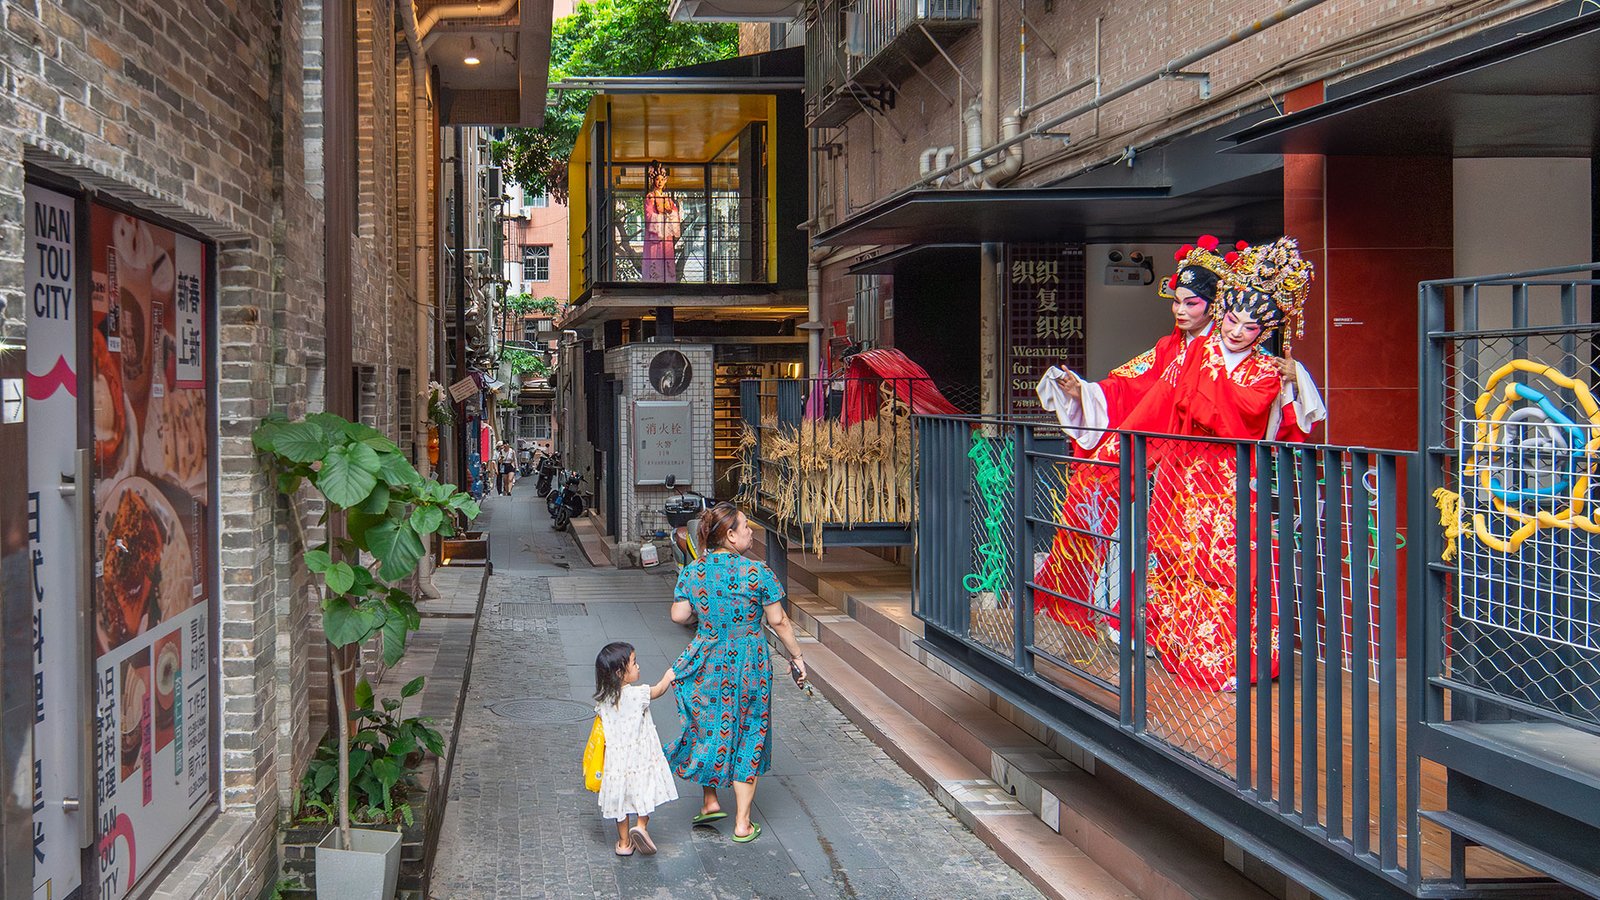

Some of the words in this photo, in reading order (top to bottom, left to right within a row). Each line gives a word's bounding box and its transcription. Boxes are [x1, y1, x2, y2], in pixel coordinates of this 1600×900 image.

[35, 202, 70, 244] NAN
[36, 242, 70, 282] TOU
[1012, 260, 1059, 284] 织织
[34, 282, 72, 321] CITY
[1036, 288, 1058, 312] 复
[1036, 315, 1083, 339] 织织
[1012, 345, 1068, 359] Weaving
[1012, 362, 1032, 374] for
[646, 422, 682, 435] 消火栓
[188, 688, 206, 720] 工作日
[104, 666, 116, 799] 日式料理
[188, 743, 206, 779] 周六日
[99, 805, 117, 840] AN
[100, 841, 116, 873] OU
[98, 867, 119, 900] ITY
